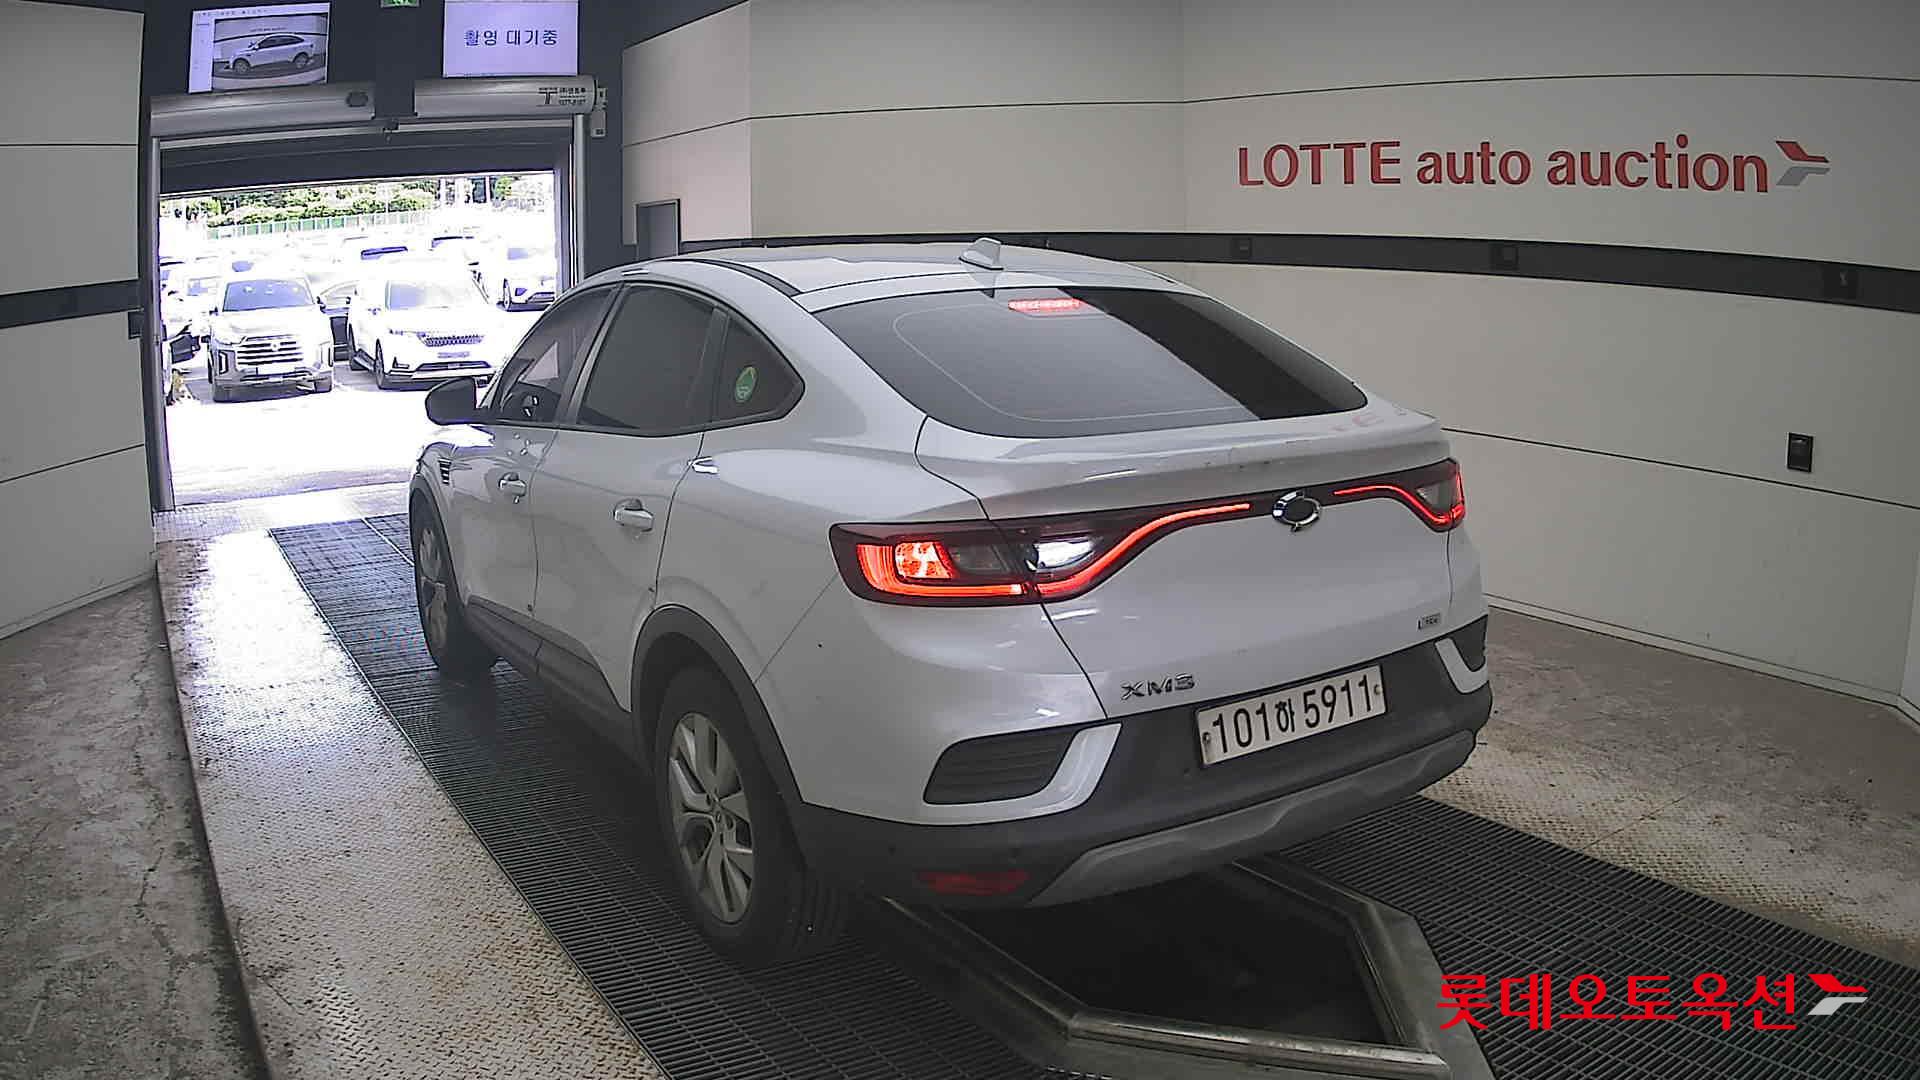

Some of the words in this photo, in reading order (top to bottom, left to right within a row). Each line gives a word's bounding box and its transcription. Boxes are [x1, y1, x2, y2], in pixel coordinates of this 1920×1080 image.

[506, 29, 558, 46] 대기중
[1239, 141, 1401, 187] LOTTE
[1416, 141, 1531, 185] auto
[1547, 134, 1768, 193] auction
[1212, 698, 1295, 754] 101하
[1303, 674, 1371, 729] 5911
